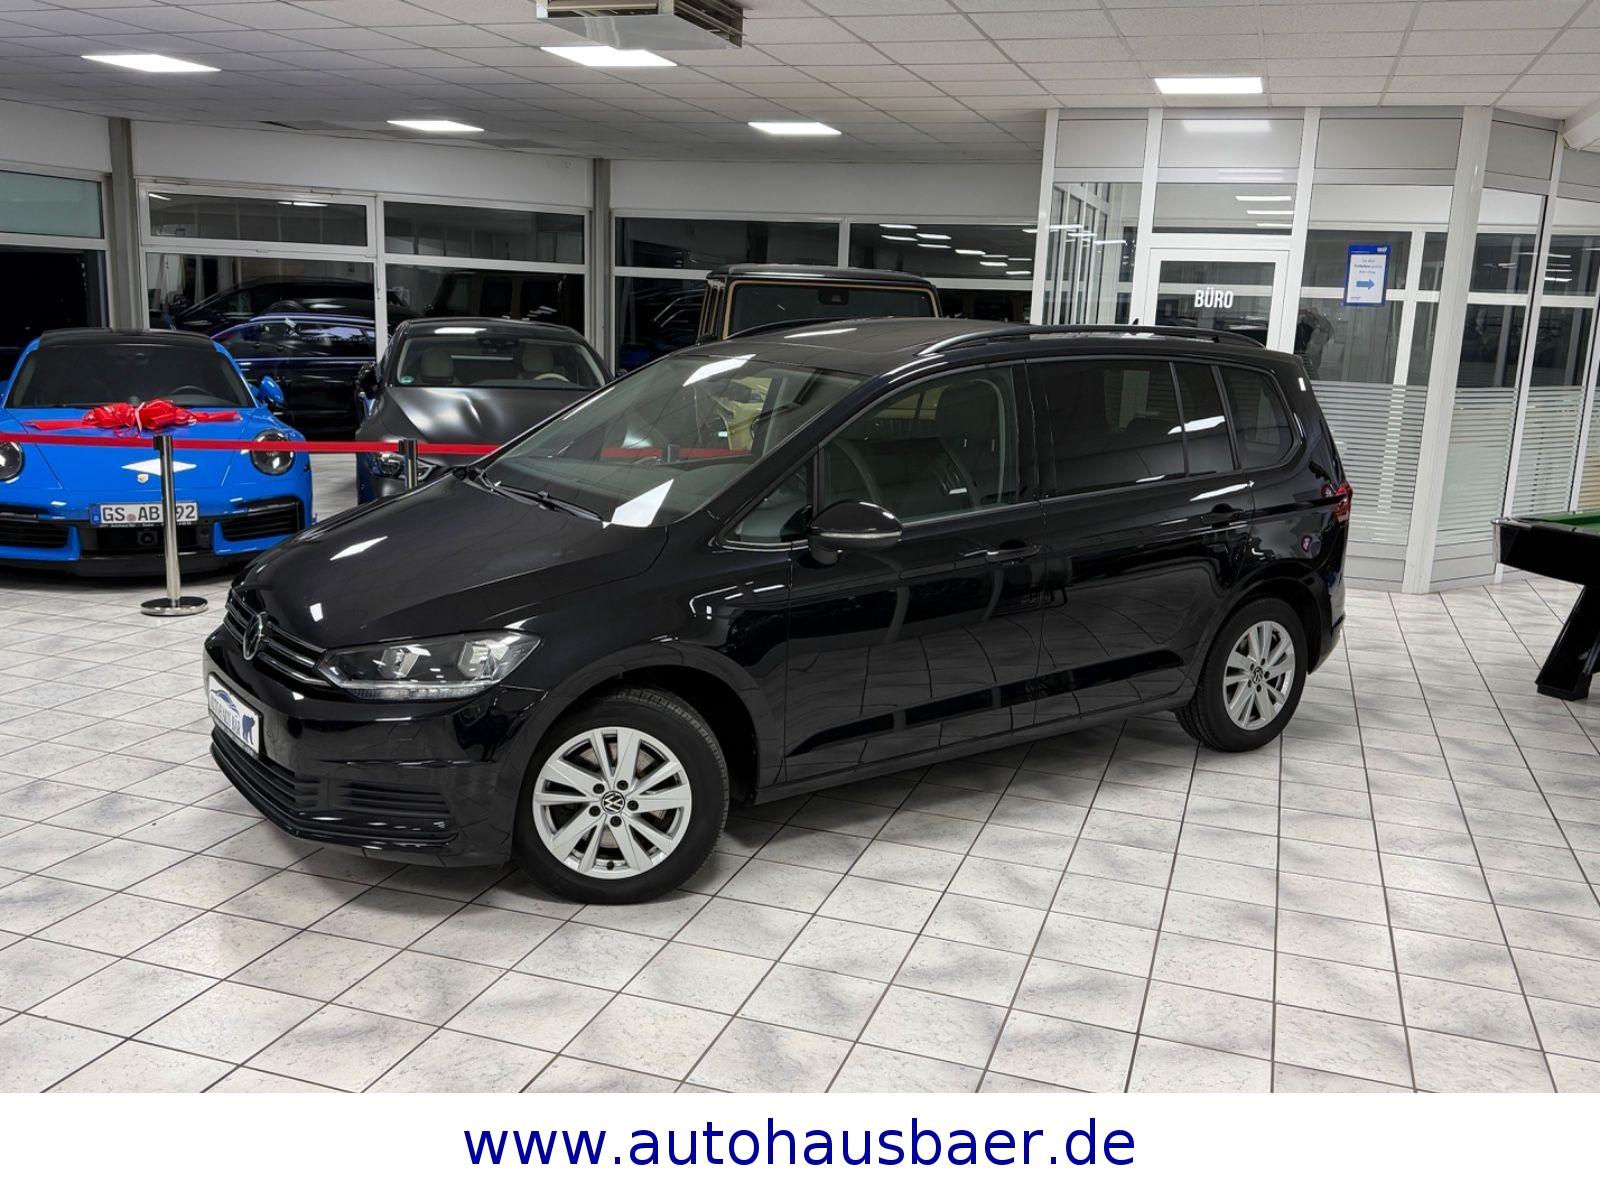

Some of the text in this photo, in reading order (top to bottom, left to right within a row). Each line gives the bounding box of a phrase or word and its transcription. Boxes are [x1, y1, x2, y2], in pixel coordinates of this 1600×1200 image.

[1194, 286, 1234, 308] BÜRO
[102, 504, 195, 522] GS AB 92
